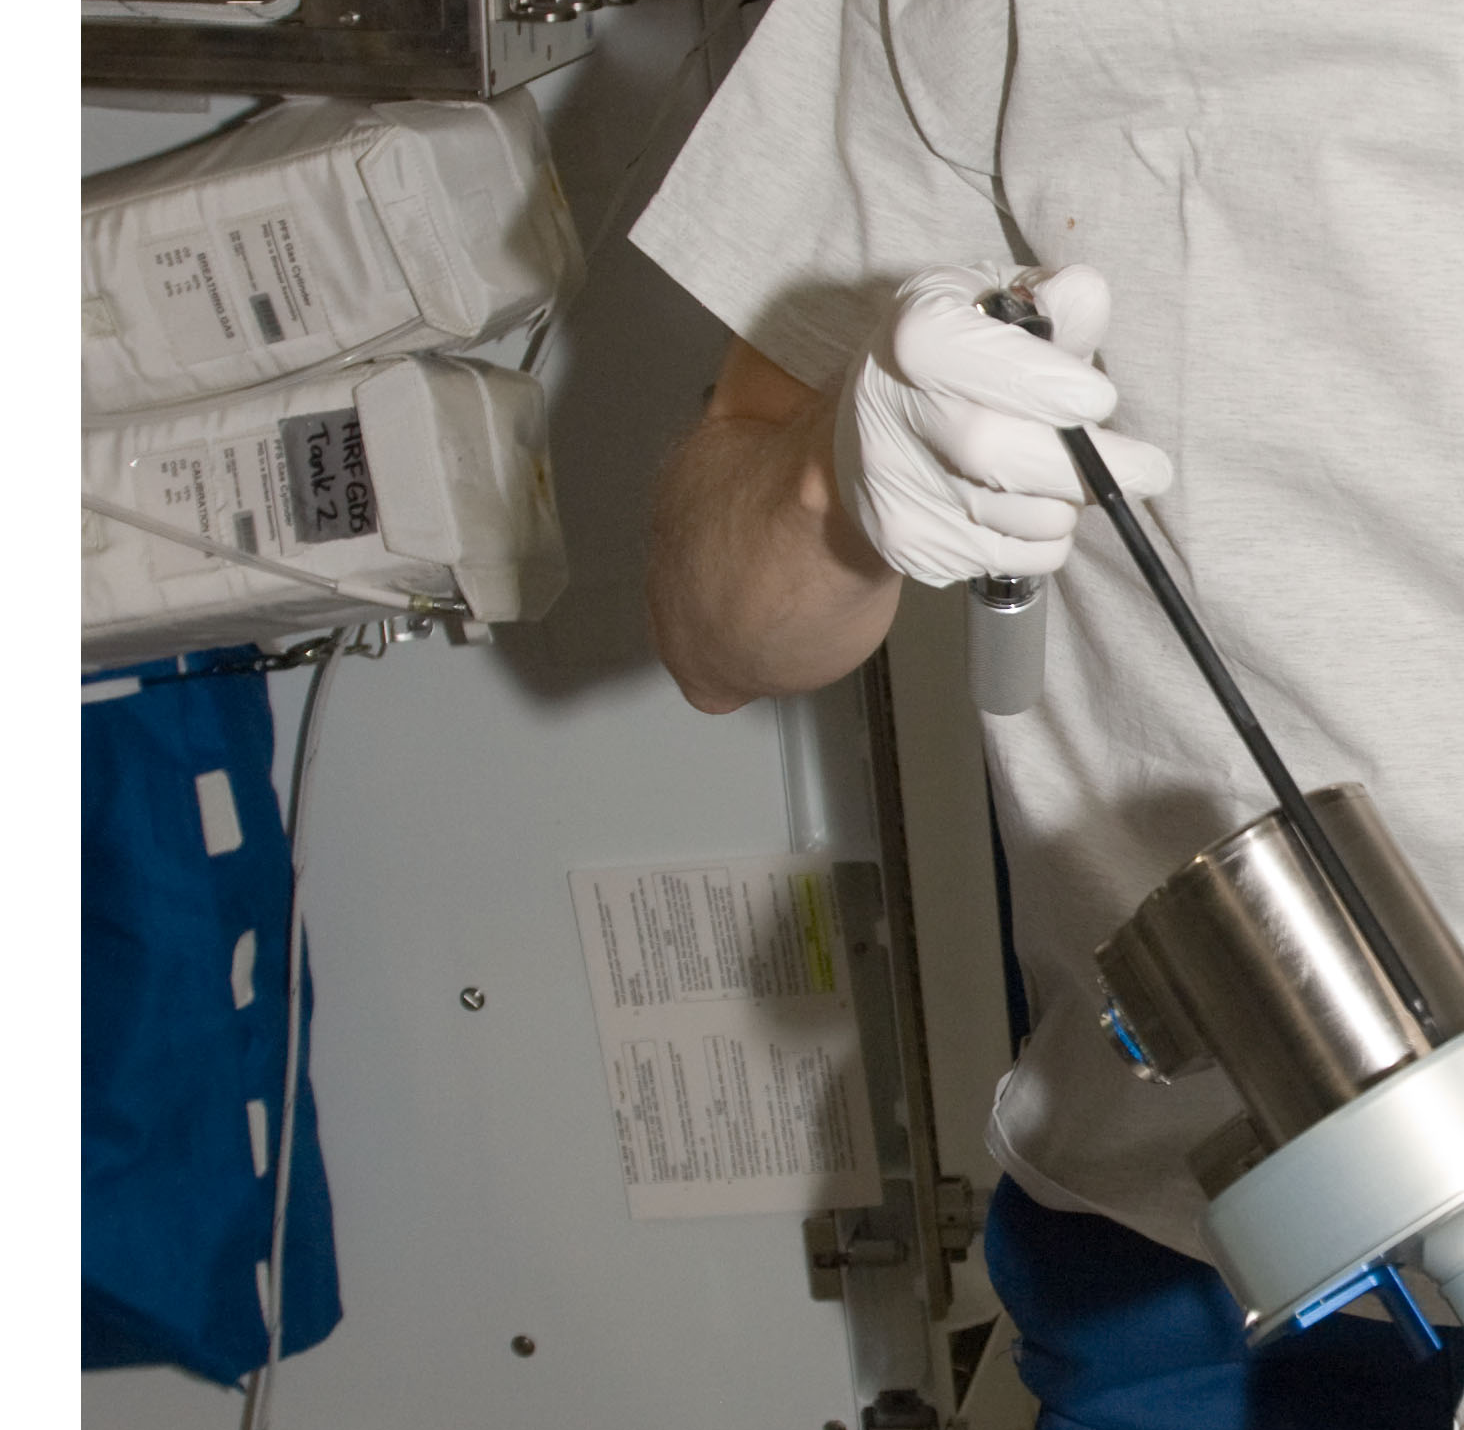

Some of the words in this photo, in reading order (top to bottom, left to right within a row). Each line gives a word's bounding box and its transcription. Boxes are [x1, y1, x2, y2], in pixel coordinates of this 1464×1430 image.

[196, 252, 225, 315] BREATHING
[220, 315, 235, 339] GAS
[284, 242, 296, 263] Gas
[291, 264, 311, 307] Cylinder
[276, 463, 288, 483] Gas
[307, 422, 336, 497] Tank
[191, 460, 210, 533] CALIBRATION
[280, 484, 293, 528] Cylinder
[316, 499, 338, 532] 2
